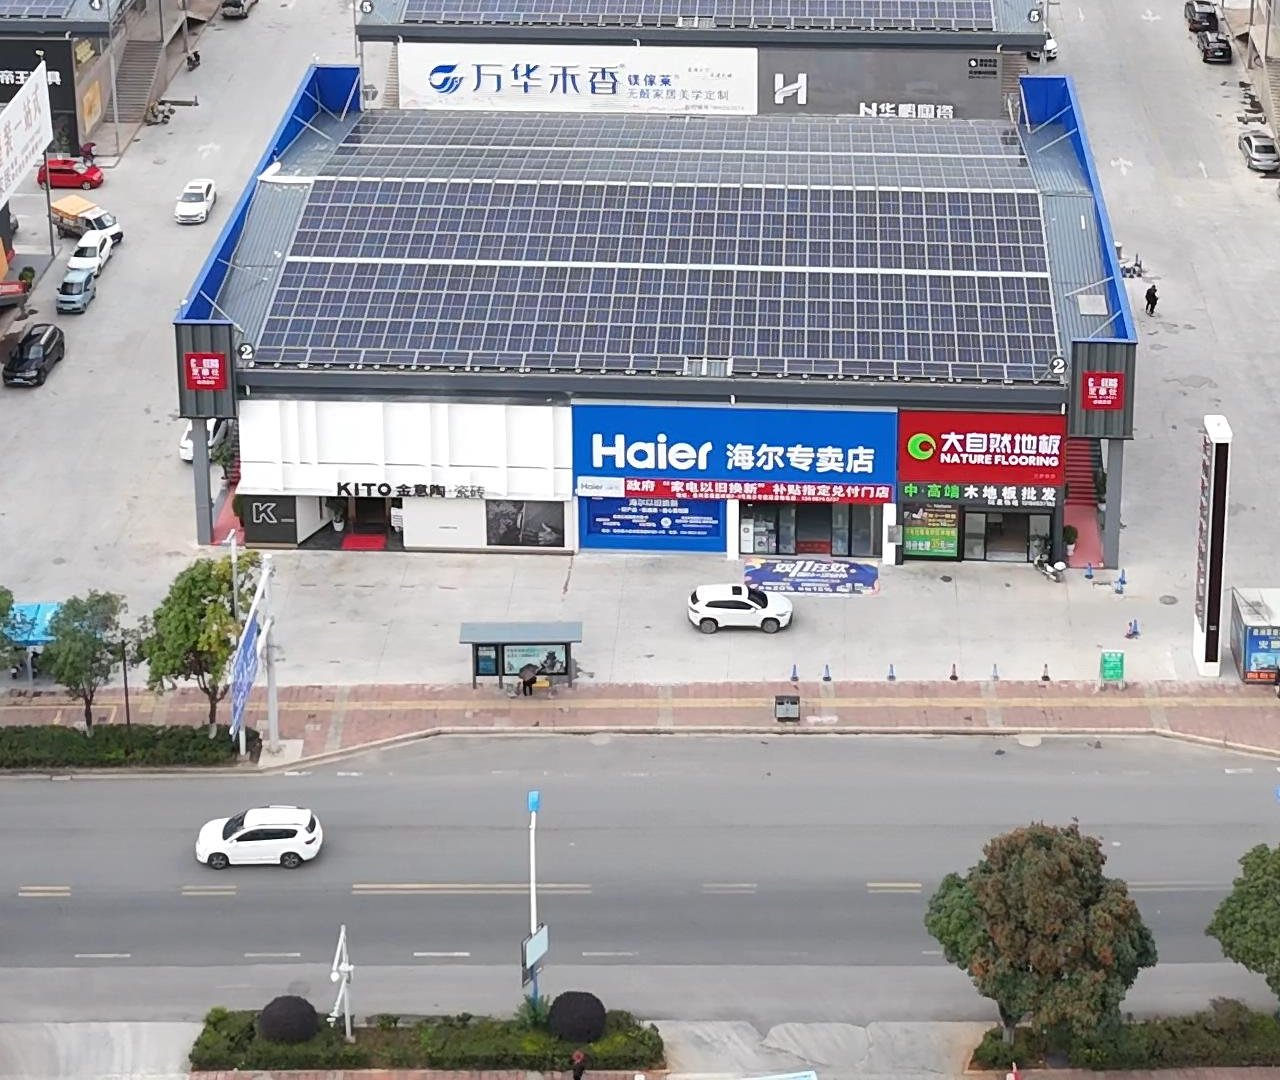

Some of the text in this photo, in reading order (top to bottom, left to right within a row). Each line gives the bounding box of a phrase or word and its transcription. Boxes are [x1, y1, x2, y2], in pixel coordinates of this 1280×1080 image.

[363, 1, 372, 12] 5
[1030, 11, 1039, 22] 5
[0, 70, 62, 85] 帝王具
[471, 63, 619, 95] 万华禾香
[240, 344, 254, 360] 2
[1051, 358, 1065, 374] 2
[940, 431, 1061, 455] 大自然地板
[592, 433, 875, 474] Haier 海尔专卖店
[940, 454, 1059, 467] NATURE FLOORING
[337, 481, 486, 499] KITO 金意陶 瓷砖
[626, 480, 656, 492] 政府
[772, 483, 890, 499] 补贴指定兑付门店
